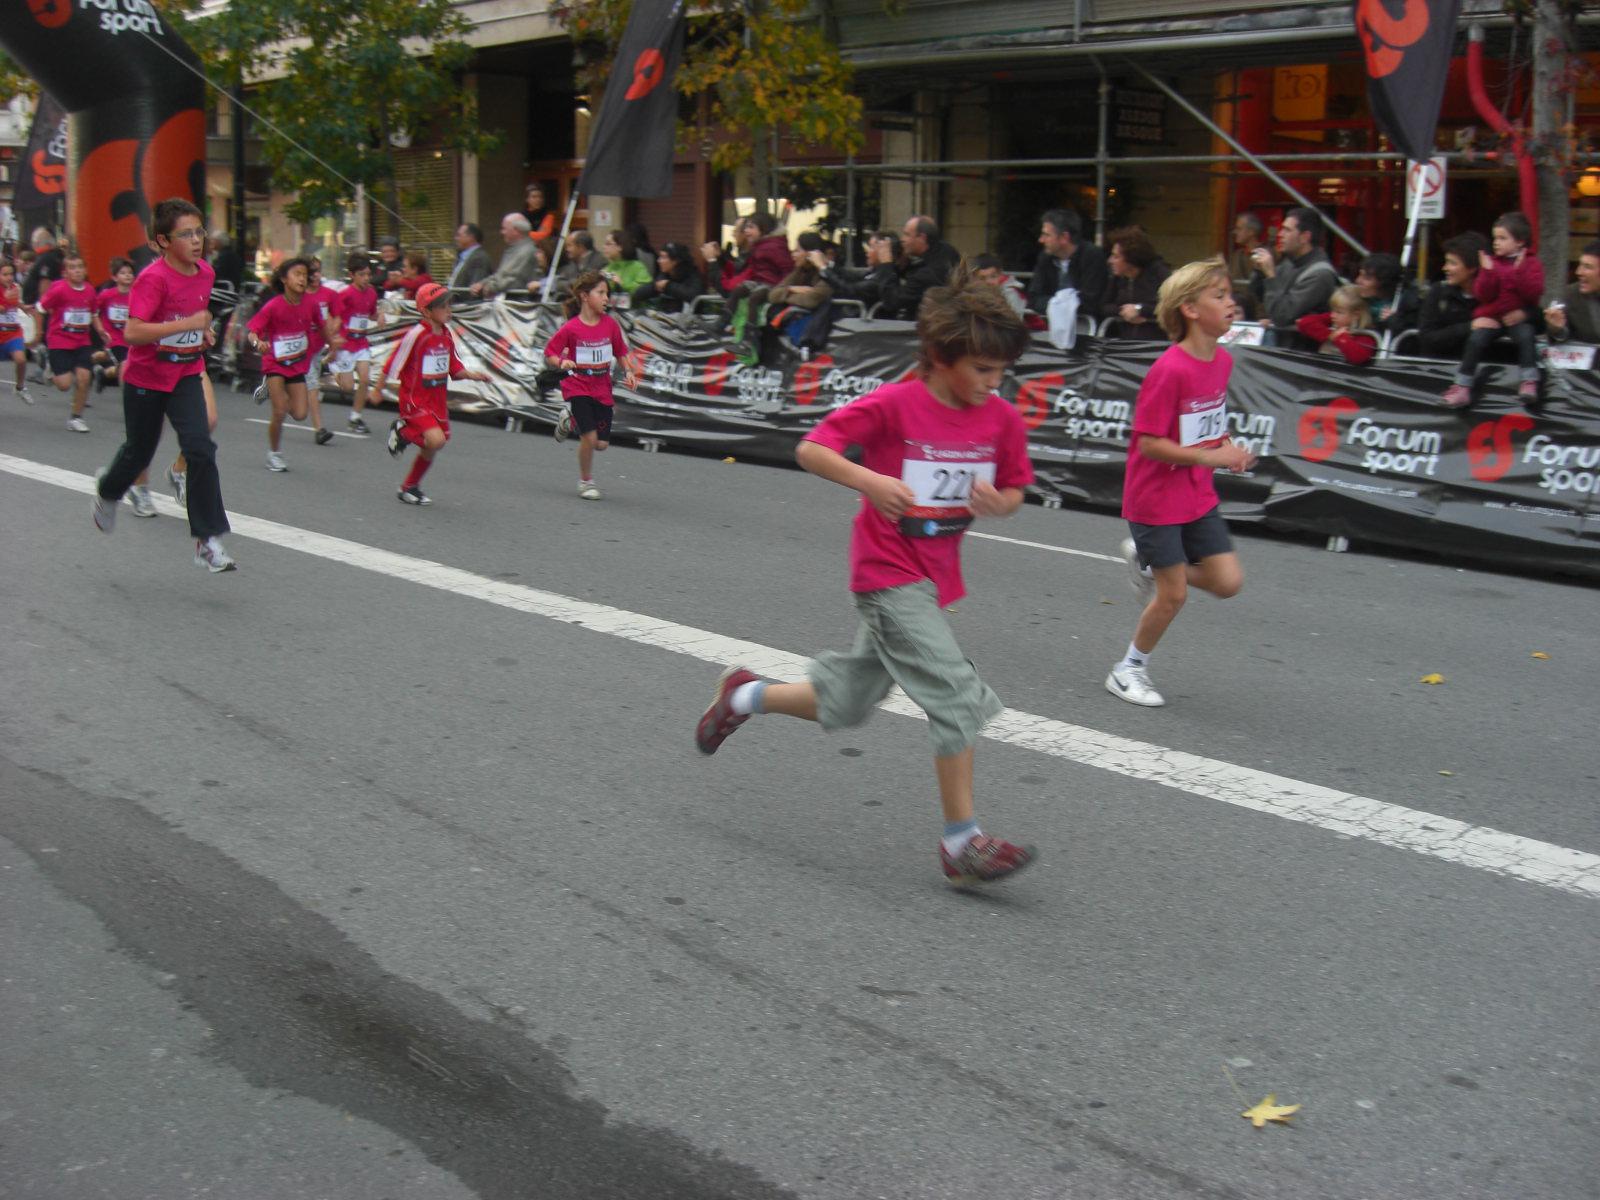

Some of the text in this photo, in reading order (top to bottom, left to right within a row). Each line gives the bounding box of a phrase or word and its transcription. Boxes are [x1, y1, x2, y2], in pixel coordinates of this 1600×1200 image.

[100, 12, 164, 35] sport
[1053, 389, 1130, 420] forum
[1064, 418, 1127, 441] sport
[1226, 411, 1276, 435] rum
[1346, 417, 1440, 454] forum
[1360, 450, 1439, 476] sport
[1521, 434, 1600, 468] foru
[1538, 468, 1600, 495] spo
